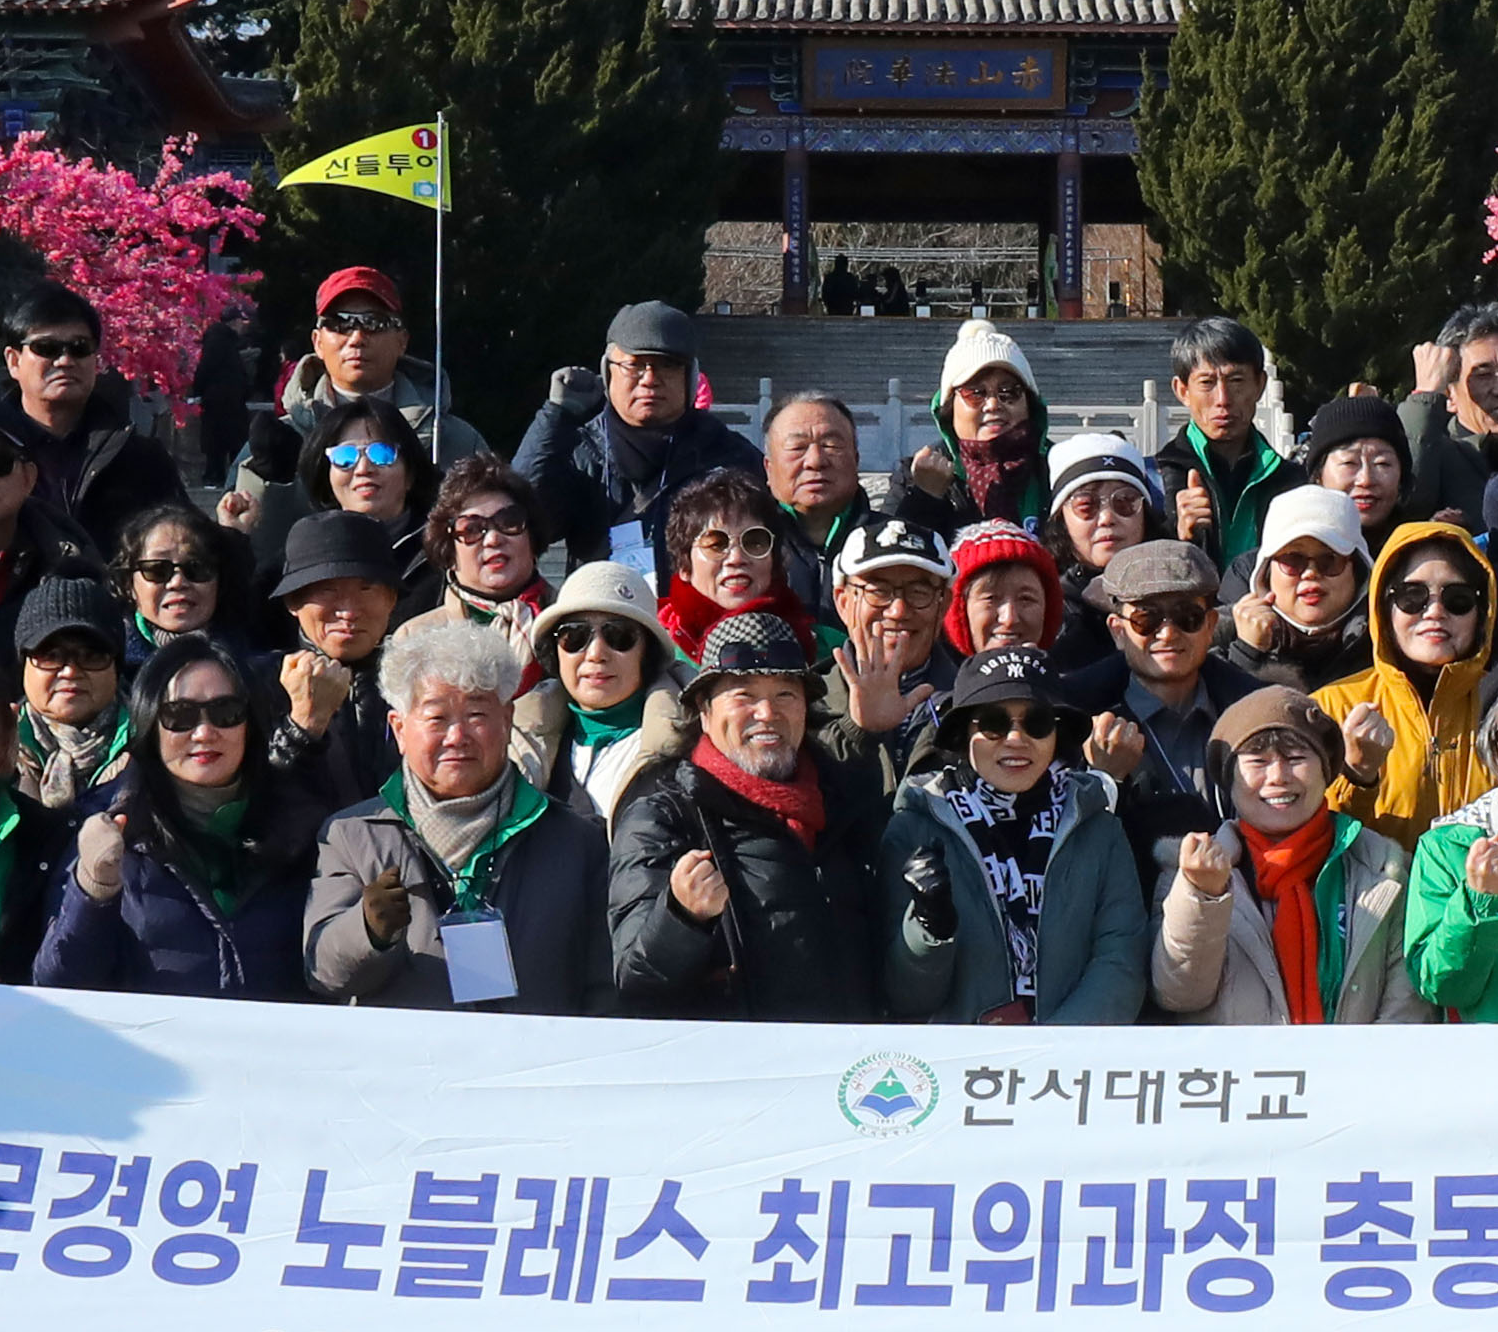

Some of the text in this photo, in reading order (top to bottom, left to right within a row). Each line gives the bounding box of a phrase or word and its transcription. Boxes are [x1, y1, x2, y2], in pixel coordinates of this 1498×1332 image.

[419, 131, 428, 147] 1
[965, 1067, 1307, 1125] 한서대학교
[282, 1170, 709, 1303] 노블레스
[748, 1178, 1275, 1312] 최고위과정
